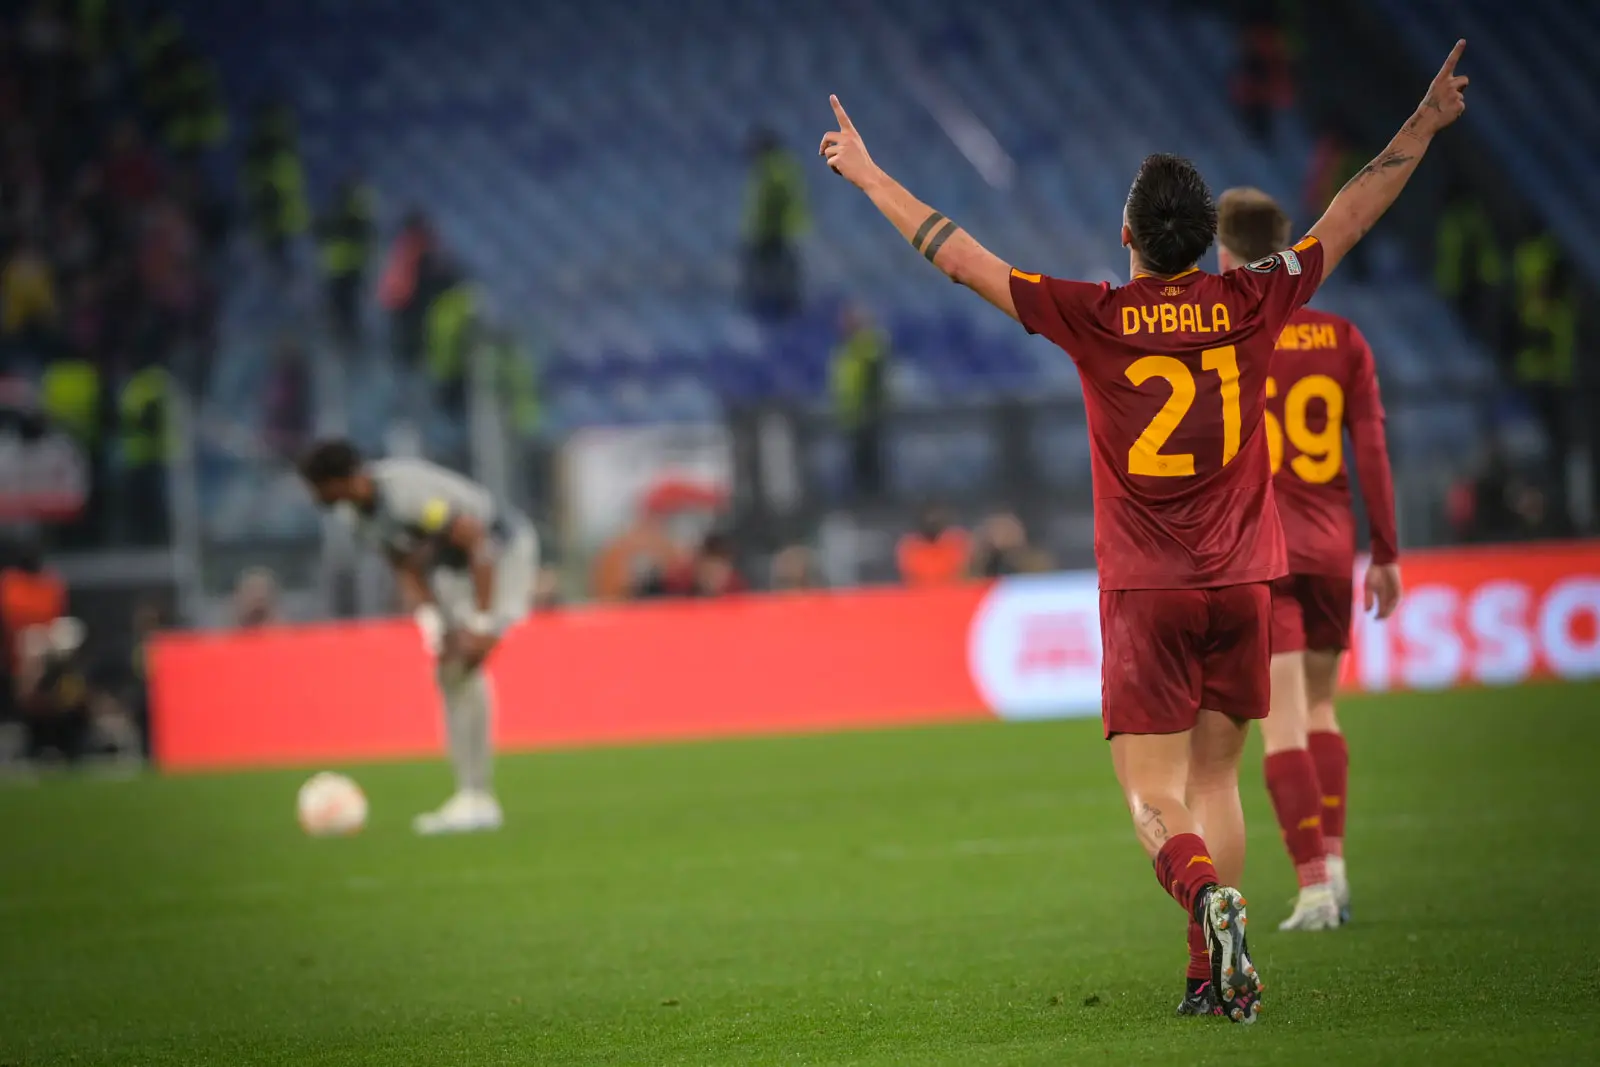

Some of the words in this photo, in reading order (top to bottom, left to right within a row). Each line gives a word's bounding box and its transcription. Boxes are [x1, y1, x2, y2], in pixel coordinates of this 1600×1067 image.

[1121, 303, 1231, 335] DYBALA
[1274, 324, 1338, 350] WSKI
[1124, 345, 1241, 477] 21
